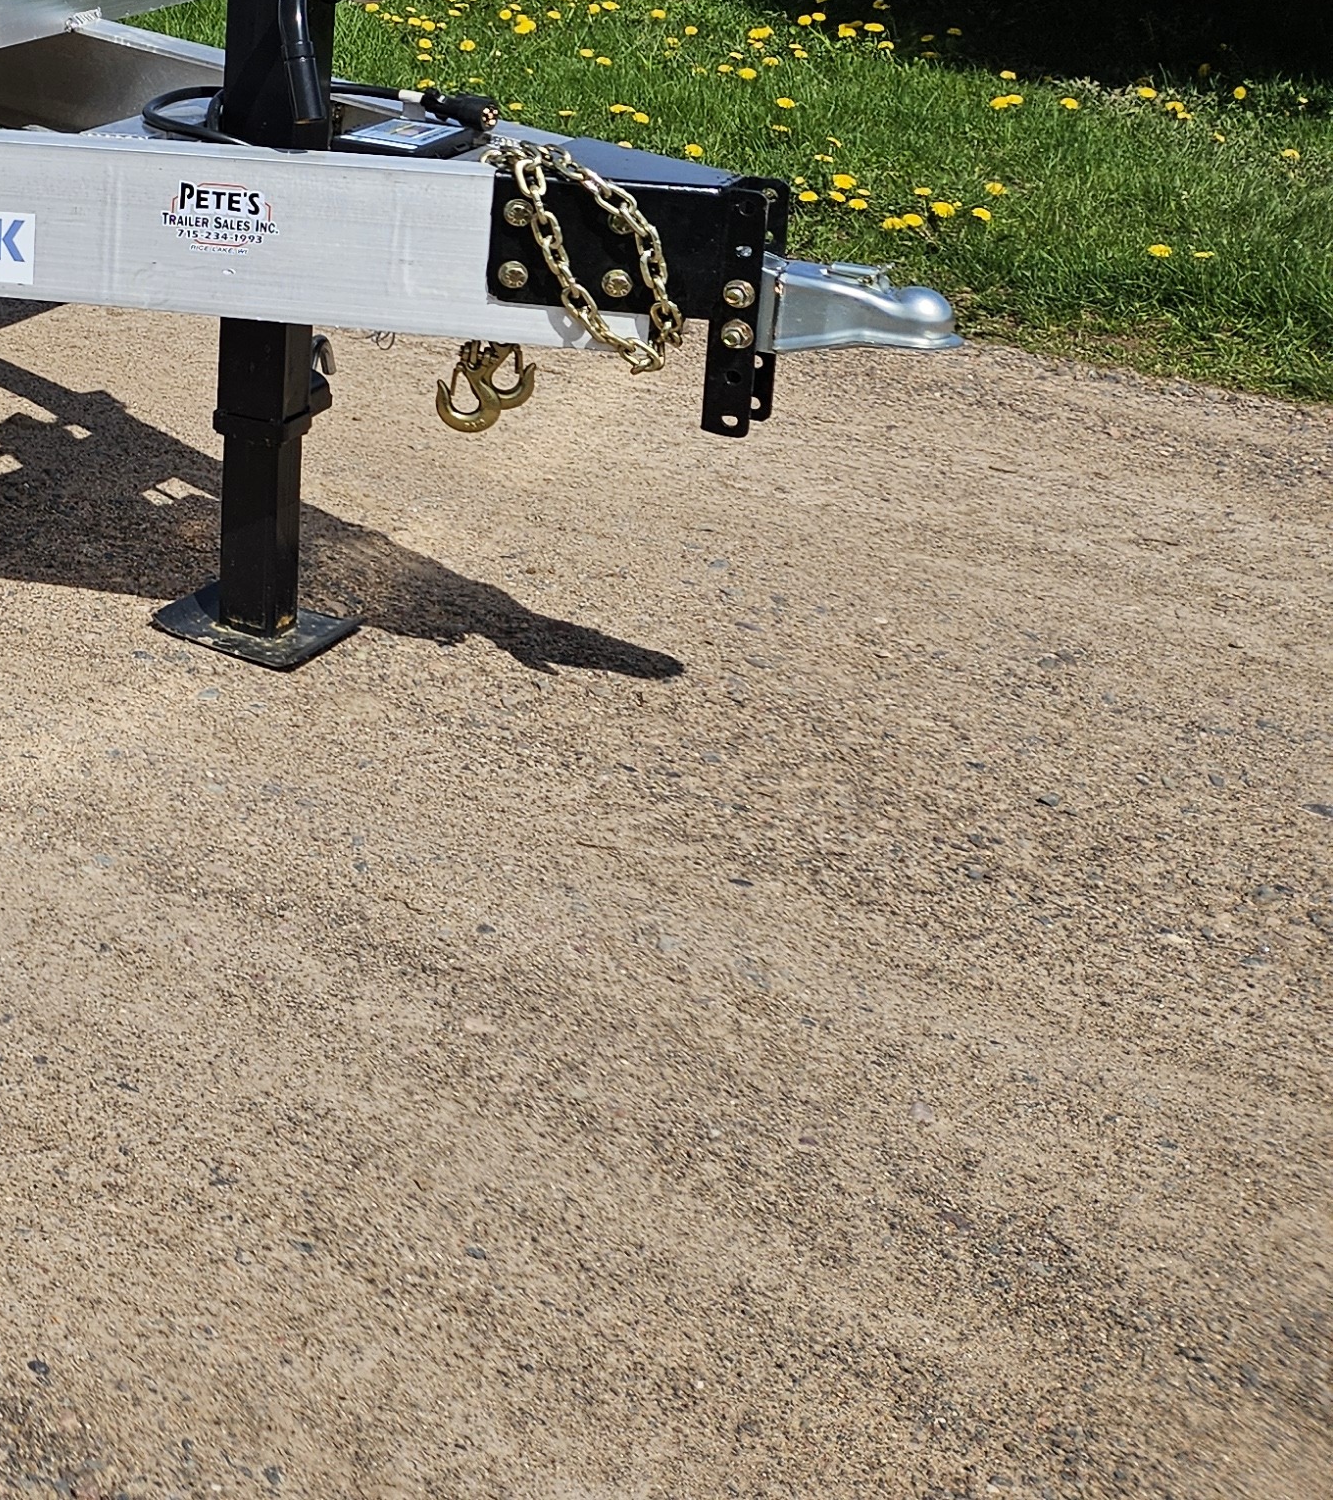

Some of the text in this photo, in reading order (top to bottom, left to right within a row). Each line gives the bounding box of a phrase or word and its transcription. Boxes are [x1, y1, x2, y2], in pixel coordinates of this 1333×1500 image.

[179, 181, 260, 216] PETE'S
[161, 211, 280, 235] TRAILER SALES INC.
[177, 228, 263, 244] 715-234-1993
[190, 244, 209, 252] RICE
